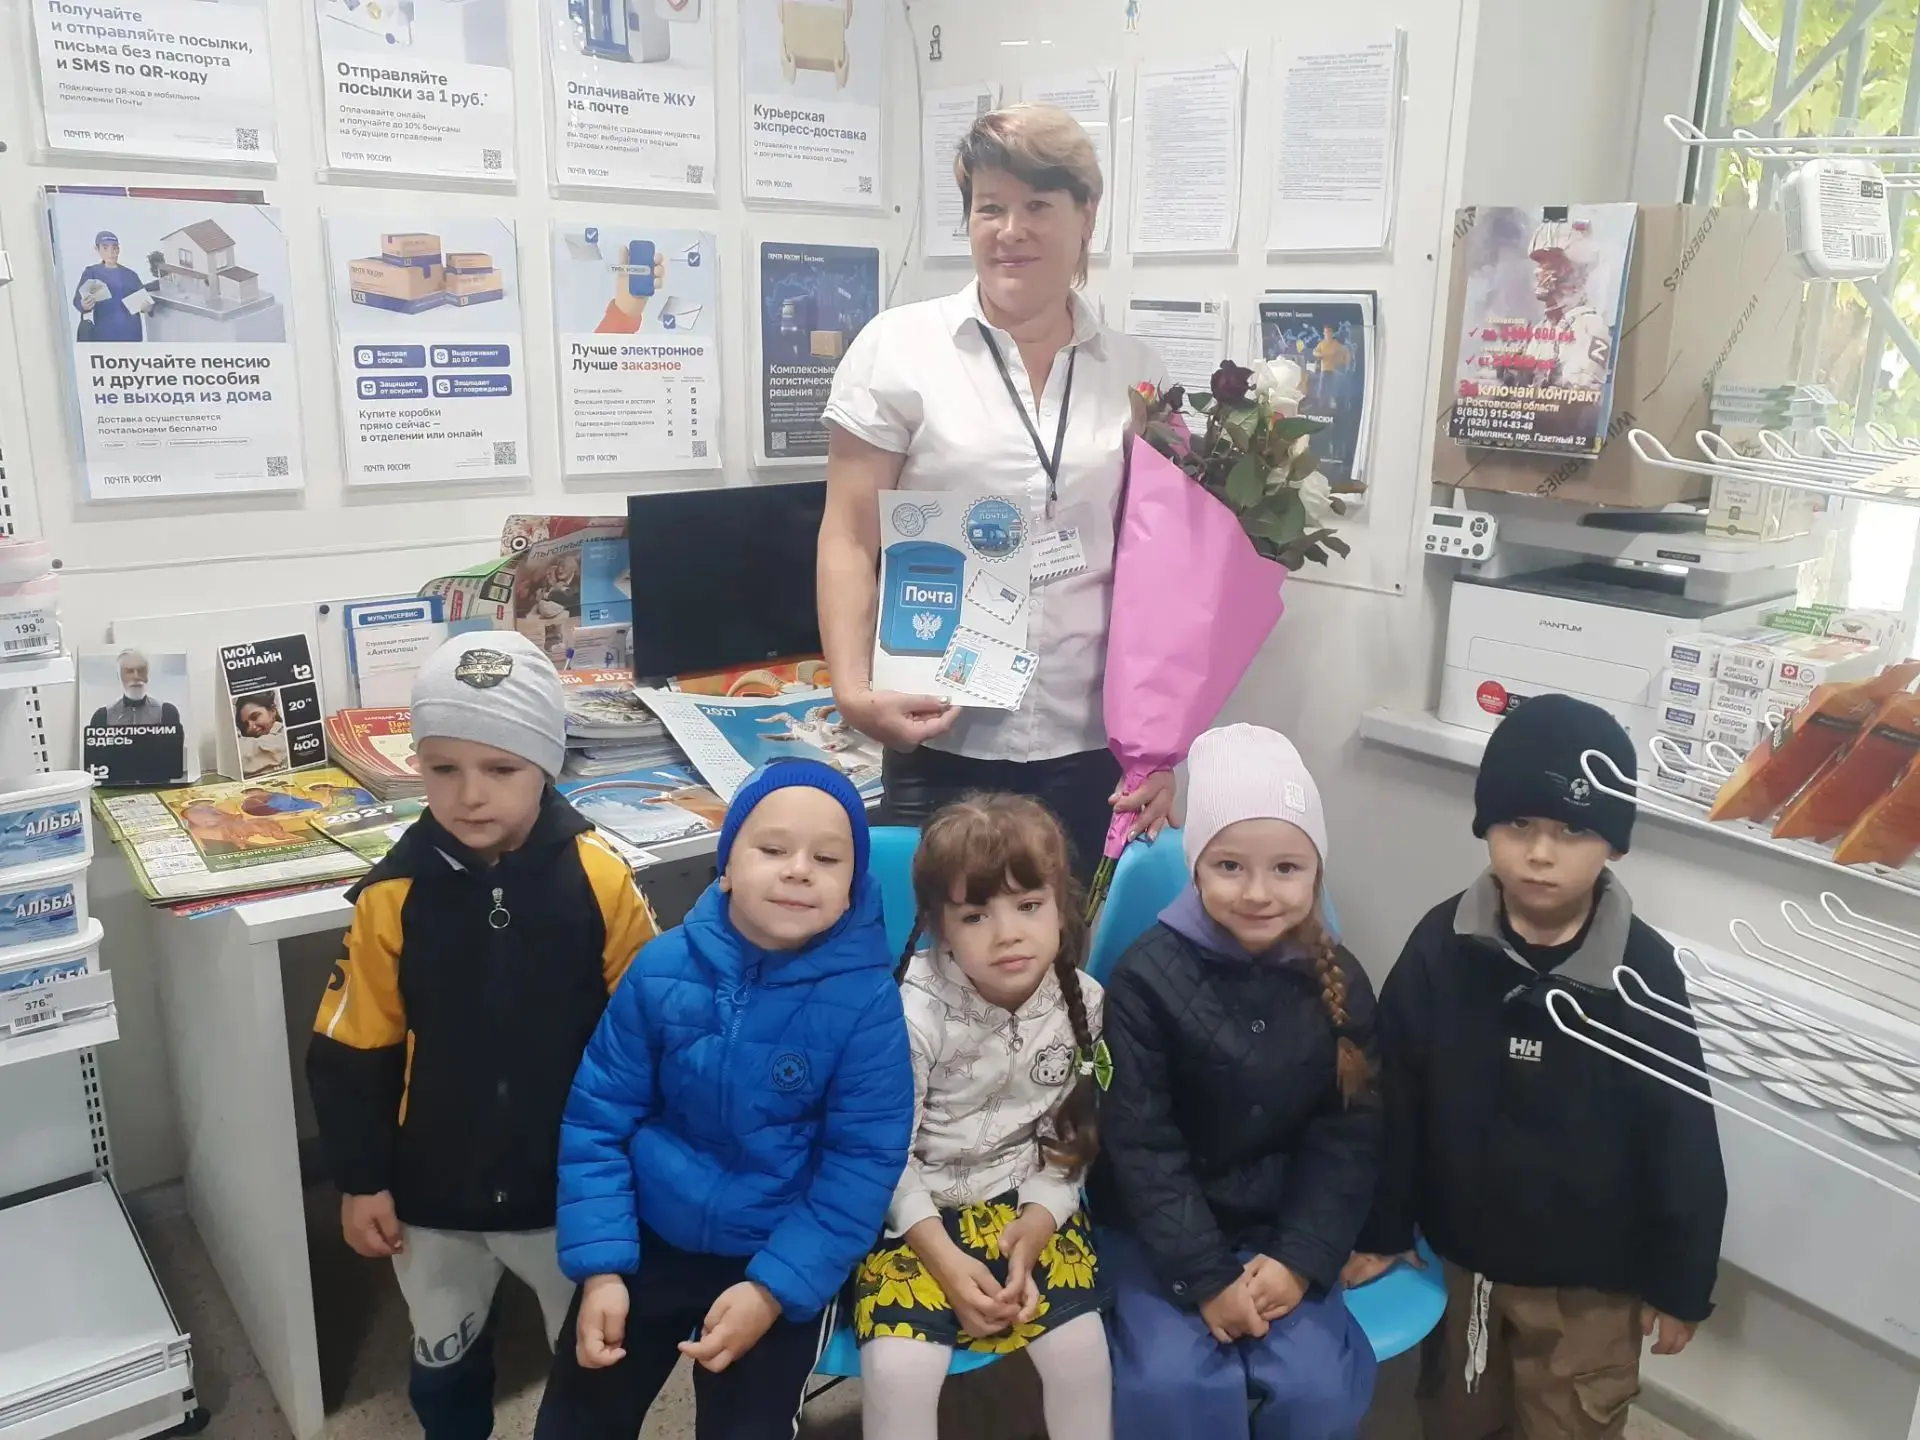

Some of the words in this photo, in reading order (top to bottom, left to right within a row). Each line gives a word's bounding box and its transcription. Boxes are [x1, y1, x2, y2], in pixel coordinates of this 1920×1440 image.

[49, 1, 142, 23] Получайте
[51, 21, 62, 32] и
[67, 23, 175, 44] отправляйте
[179, 35, 253, 54] посылки,
[54, 40, 117, 56] письма
[122, 45, 151, 59] без
[156, 51, 230, 67] паспорта
[57, 58, 67, 69] и
[72, 58, 110, 73] SMS
[115, 64, 135, 76] по
[140, 65, 208, 85] QR-коду
[337, 62, 447, 86] Отправляйте
[59, 82, 112, 94] Подключите
[115, 87, 146, 98] QR-код
[339, 82, 412, 100] посылки
[417, 90, 435, 102] за
[439, 89, 448, 102] 1
[567, 81, 660, 103] Оплачивайте
[663, 92, 696, 107] ЖКУ
[339, 105, 394, 117] Оплачивайте
[396, 110, 426, 120] онлайн
[568, 99, 584, 111] на
[589, 101, 629, 115] почте
[753, 103, 825, 123] Курьерская
[347, 117, 391, 129] получайте
[392, 121, 403, 129] до
[405, 121, 420, 130] 10%
[753, 121, 867, 141] экспресс-доставка
[64, 129, 91, 139] ПОЧТА
[94, 131, 124, 142] РОССИИ
[352, 128, 389, 139] будущие
[341, 152, 364, 161] ПОЧТА
[1662, 206, 1720, 293] ILDBERRIES
[572, 343, 617, 357] Лучше
[621, 345, 704, 358] электронное
[91, 354, 196, 373] Получайте
[201, 355, 271, 369] пенсию
[572, 359, 618, 373] Лучше
[621, 360, 681, 371] заказное
[770, 364, 836, 375] Комплексные
[93, 374, 104, 387] и
[110, 372, 178, 390] другие
[183, 371, 260, 386] пособия
[770, 377, 833, 386] логистическ
[94, 392, 118, 405] не
[124, 390, 195, 406] выходя
[200, 390, 222, 403] из
[226, 389, 272, 405] дома
[770, 388, 813, 399] решения
[1538, 386, 1601, 404] контракт
[1456, 407, 1488, 418] 8(863)
[1466, 398, 1521, 409] Ростовской
[1523, 401, 1560, 412] области
[97, 415, 143, 425] Доставка
[145, 413, 222, 424] осуществляется
[359, 409, 396, 420] Купите
[399, 408, 442, 420] коробки
[98, 424, 167, 435] почтальонами
[168, 422, 218, 434] бесплатно
[360, 422, 393, 431] прямо
[395, 420, 431, 430] сейчас
[369, 432, 424, 443] отделении
[426, 431, 444, 440] или
[447, 429, 483, 440] онлайн
[1467, 429, 1513, 440] Цимлянск,
[1516, 433, 1532, 441] пер.
[1534, 434, 1574, 444] Газетный
[1575, 436, 1587, 445] 32
[364, 464, 385, 472] ПОЧТА
[104, 475, 131, 485] ПОЧТА
[133, 474, 161, 484] РОССИИ
[905, 586, 953, 603] Почта
[367, 611, 418, 621] МУЛЬТИСЕРВИС
[1538, 620, 1582, 632] PANTUM
[224, 645, 255, 660] МОЙ
[227, 652, 282, 670] ОНЛАЙН
[292, 664, 312, 680] t2
[592, 672, 633, 682] 2027
[288, 700, 305, 711] 20
[702, 706, 736, 718] 2027
[86, 726, 176, 737] ПОДКЛЮЧИМ
[86, 736, 133, 747] ЗДЕСЬ
[293, 739, 320, 751] 400
[90, 764, 109, 779] t2
[325, 805, 394, 824] 2027
[25, 809, 82, 837] АЛЬБА
[16, 892, 74, 919] АЛЬБА
